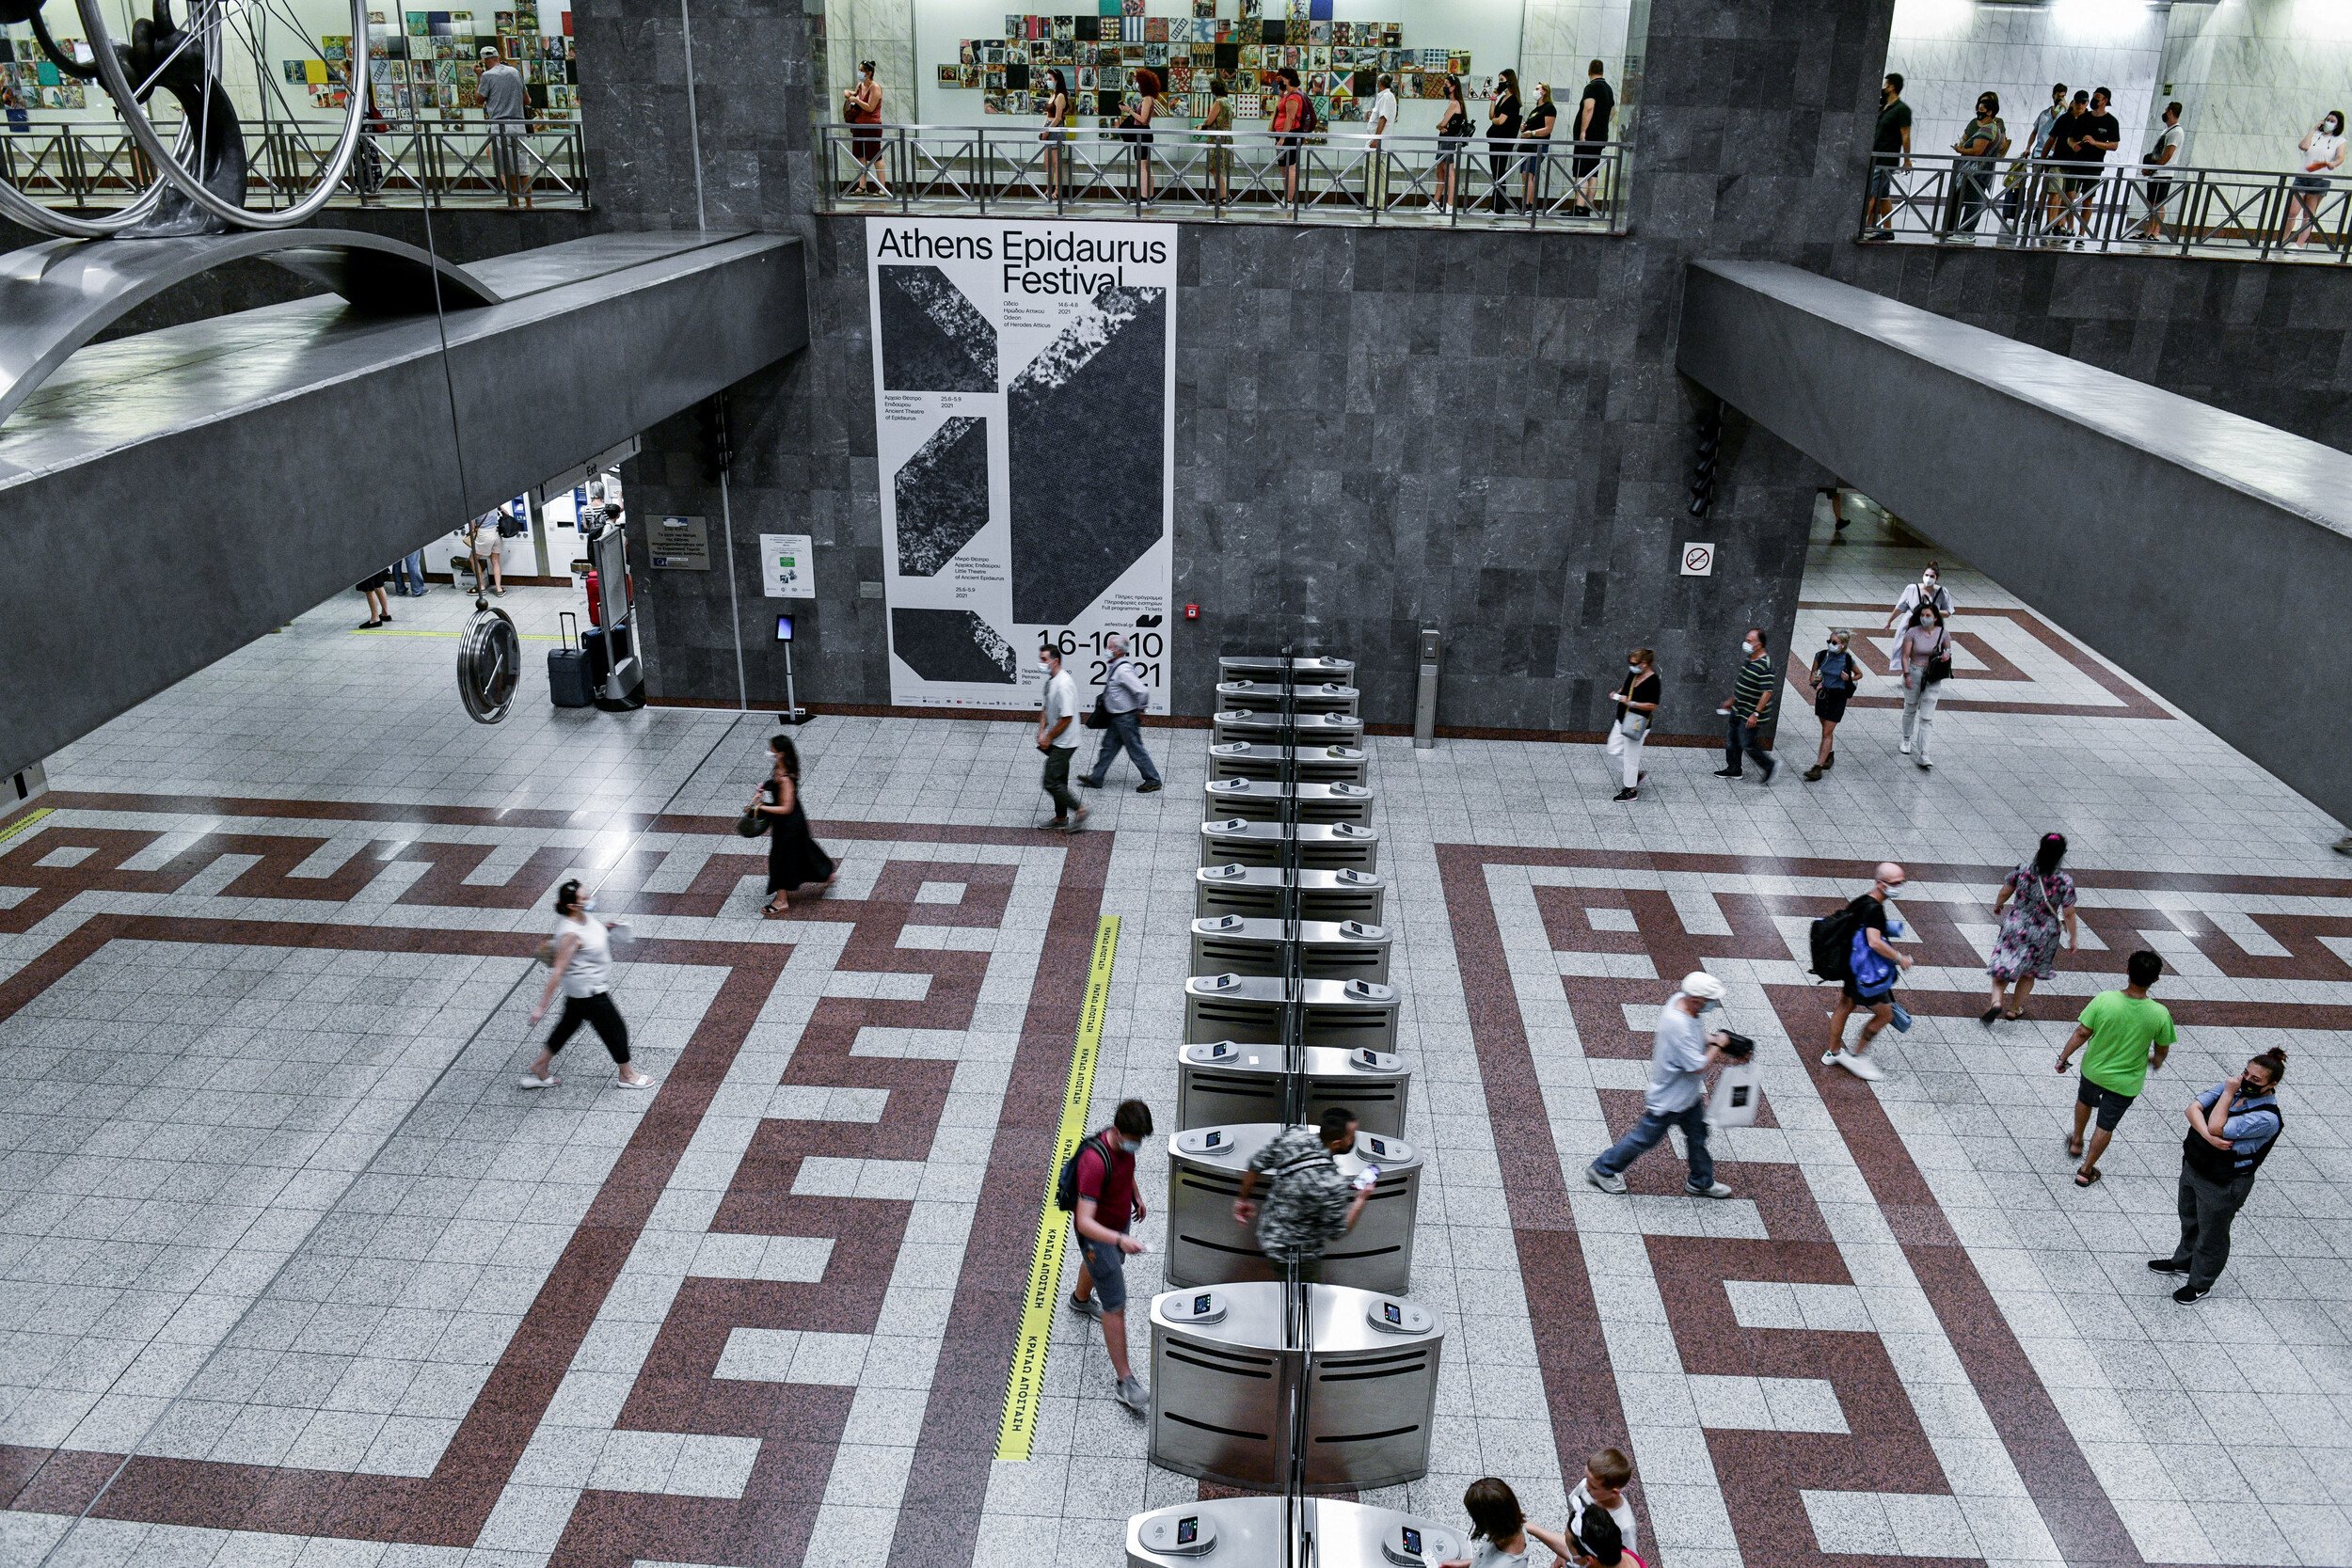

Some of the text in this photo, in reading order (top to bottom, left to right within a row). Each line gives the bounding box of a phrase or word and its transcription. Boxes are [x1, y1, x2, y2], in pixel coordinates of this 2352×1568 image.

[878, 228, 1167, 268] Athens Epidaurus
[1004, 264, 1123, 294] Festival
[587, 464, 597, 477] Exit
[1089, 661, 1160, 687] 221
[1073, 1048, 1089, 1105] ΚΡΑΤΑΩ ΑΠΟΣΤΑΣΗ
[1034, 1228, 1057, 1308] ΚΡΑΤΑΩ ΑΠΟΣΤΑΣΗ
[1012, 1336, 1038, 1432] ΚΡΑΤΑΩ ΑΠΟΣΤΑΣΗ
